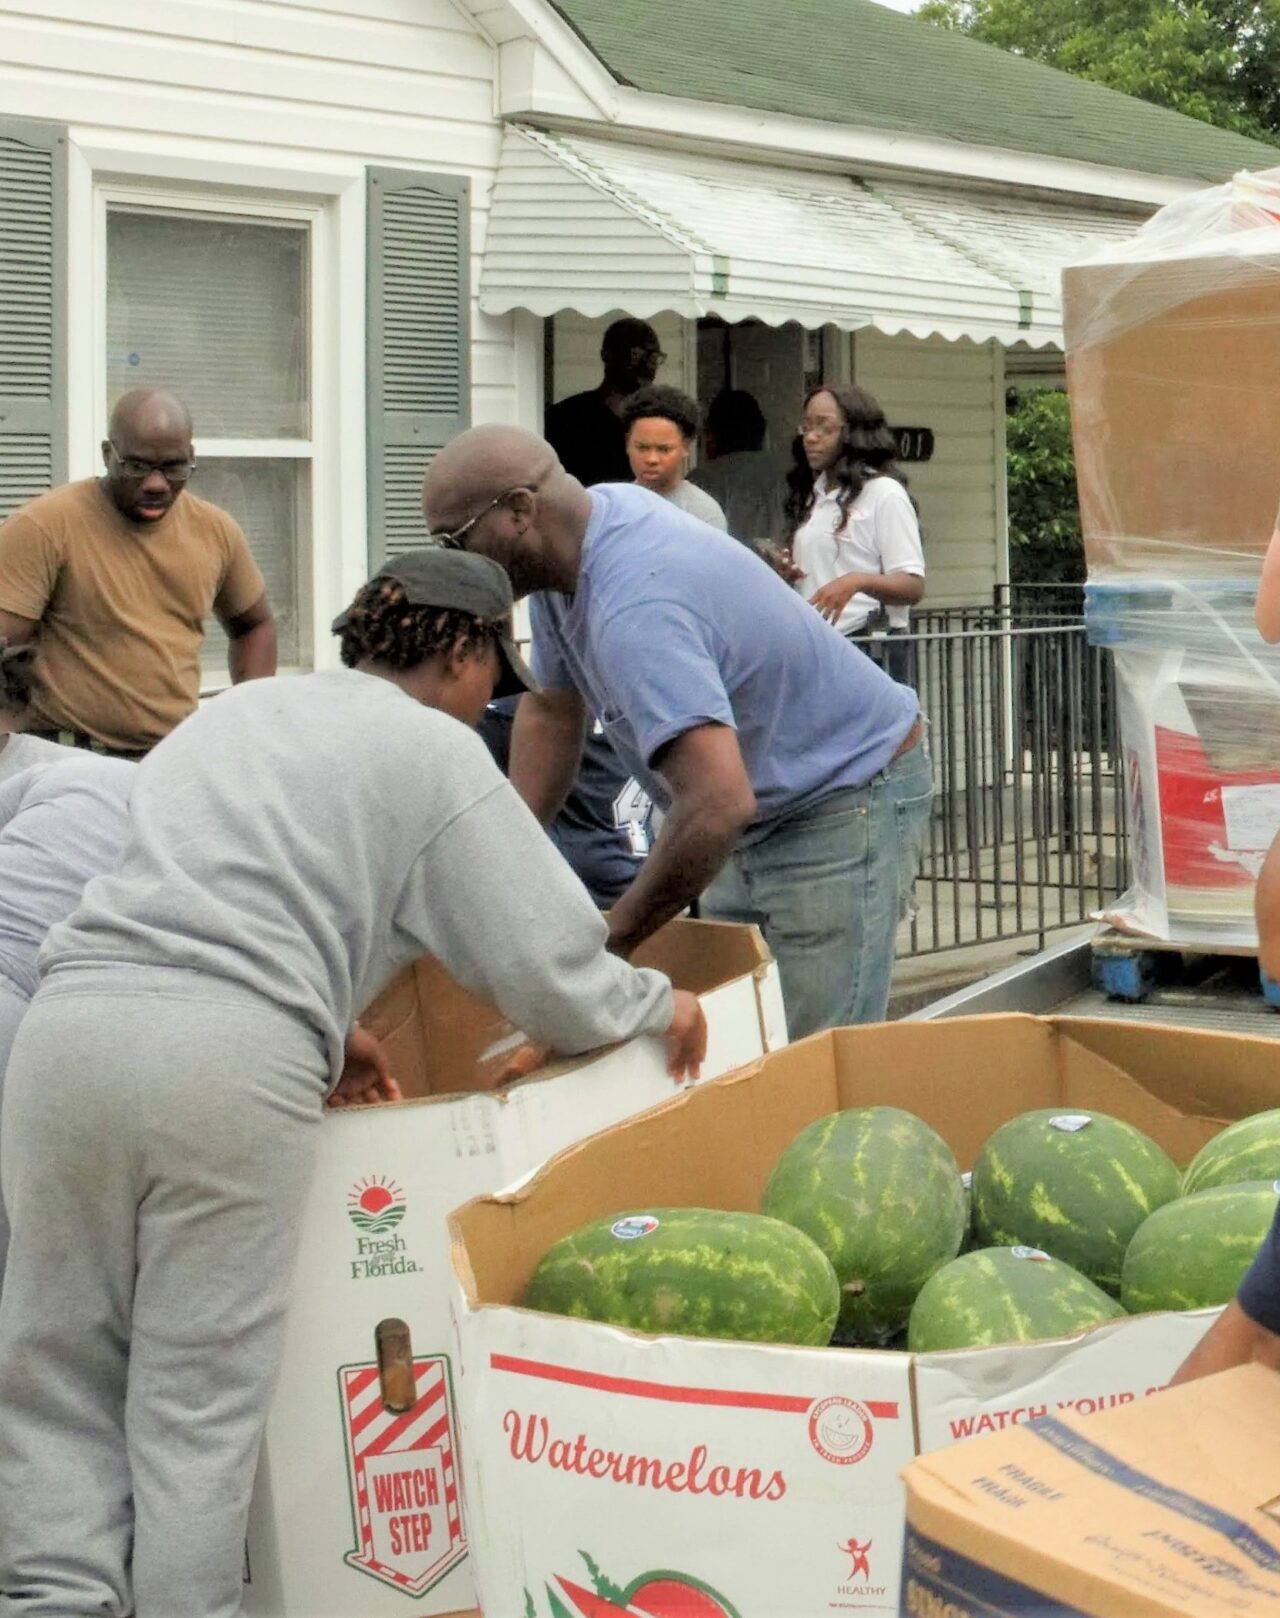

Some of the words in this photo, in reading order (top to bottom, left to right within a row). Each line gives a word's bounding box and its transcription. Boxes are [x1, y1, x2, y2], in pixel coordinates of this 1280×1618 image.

[357, 1233, 407, 1255] Fresh
[949, 1405, 1047, 1440] WATCH
[1057, 1391, 1136, 1416] OUR
[503, 1409, 787, 1501] Watermelons
[372, 1467, 439, 1513] WATCH
[999, 1463, 1066, 1500] FRAGILE
[388, 1512, 433, 1556] STEP
[837, 1586, 886, 1596] HEALTHY
